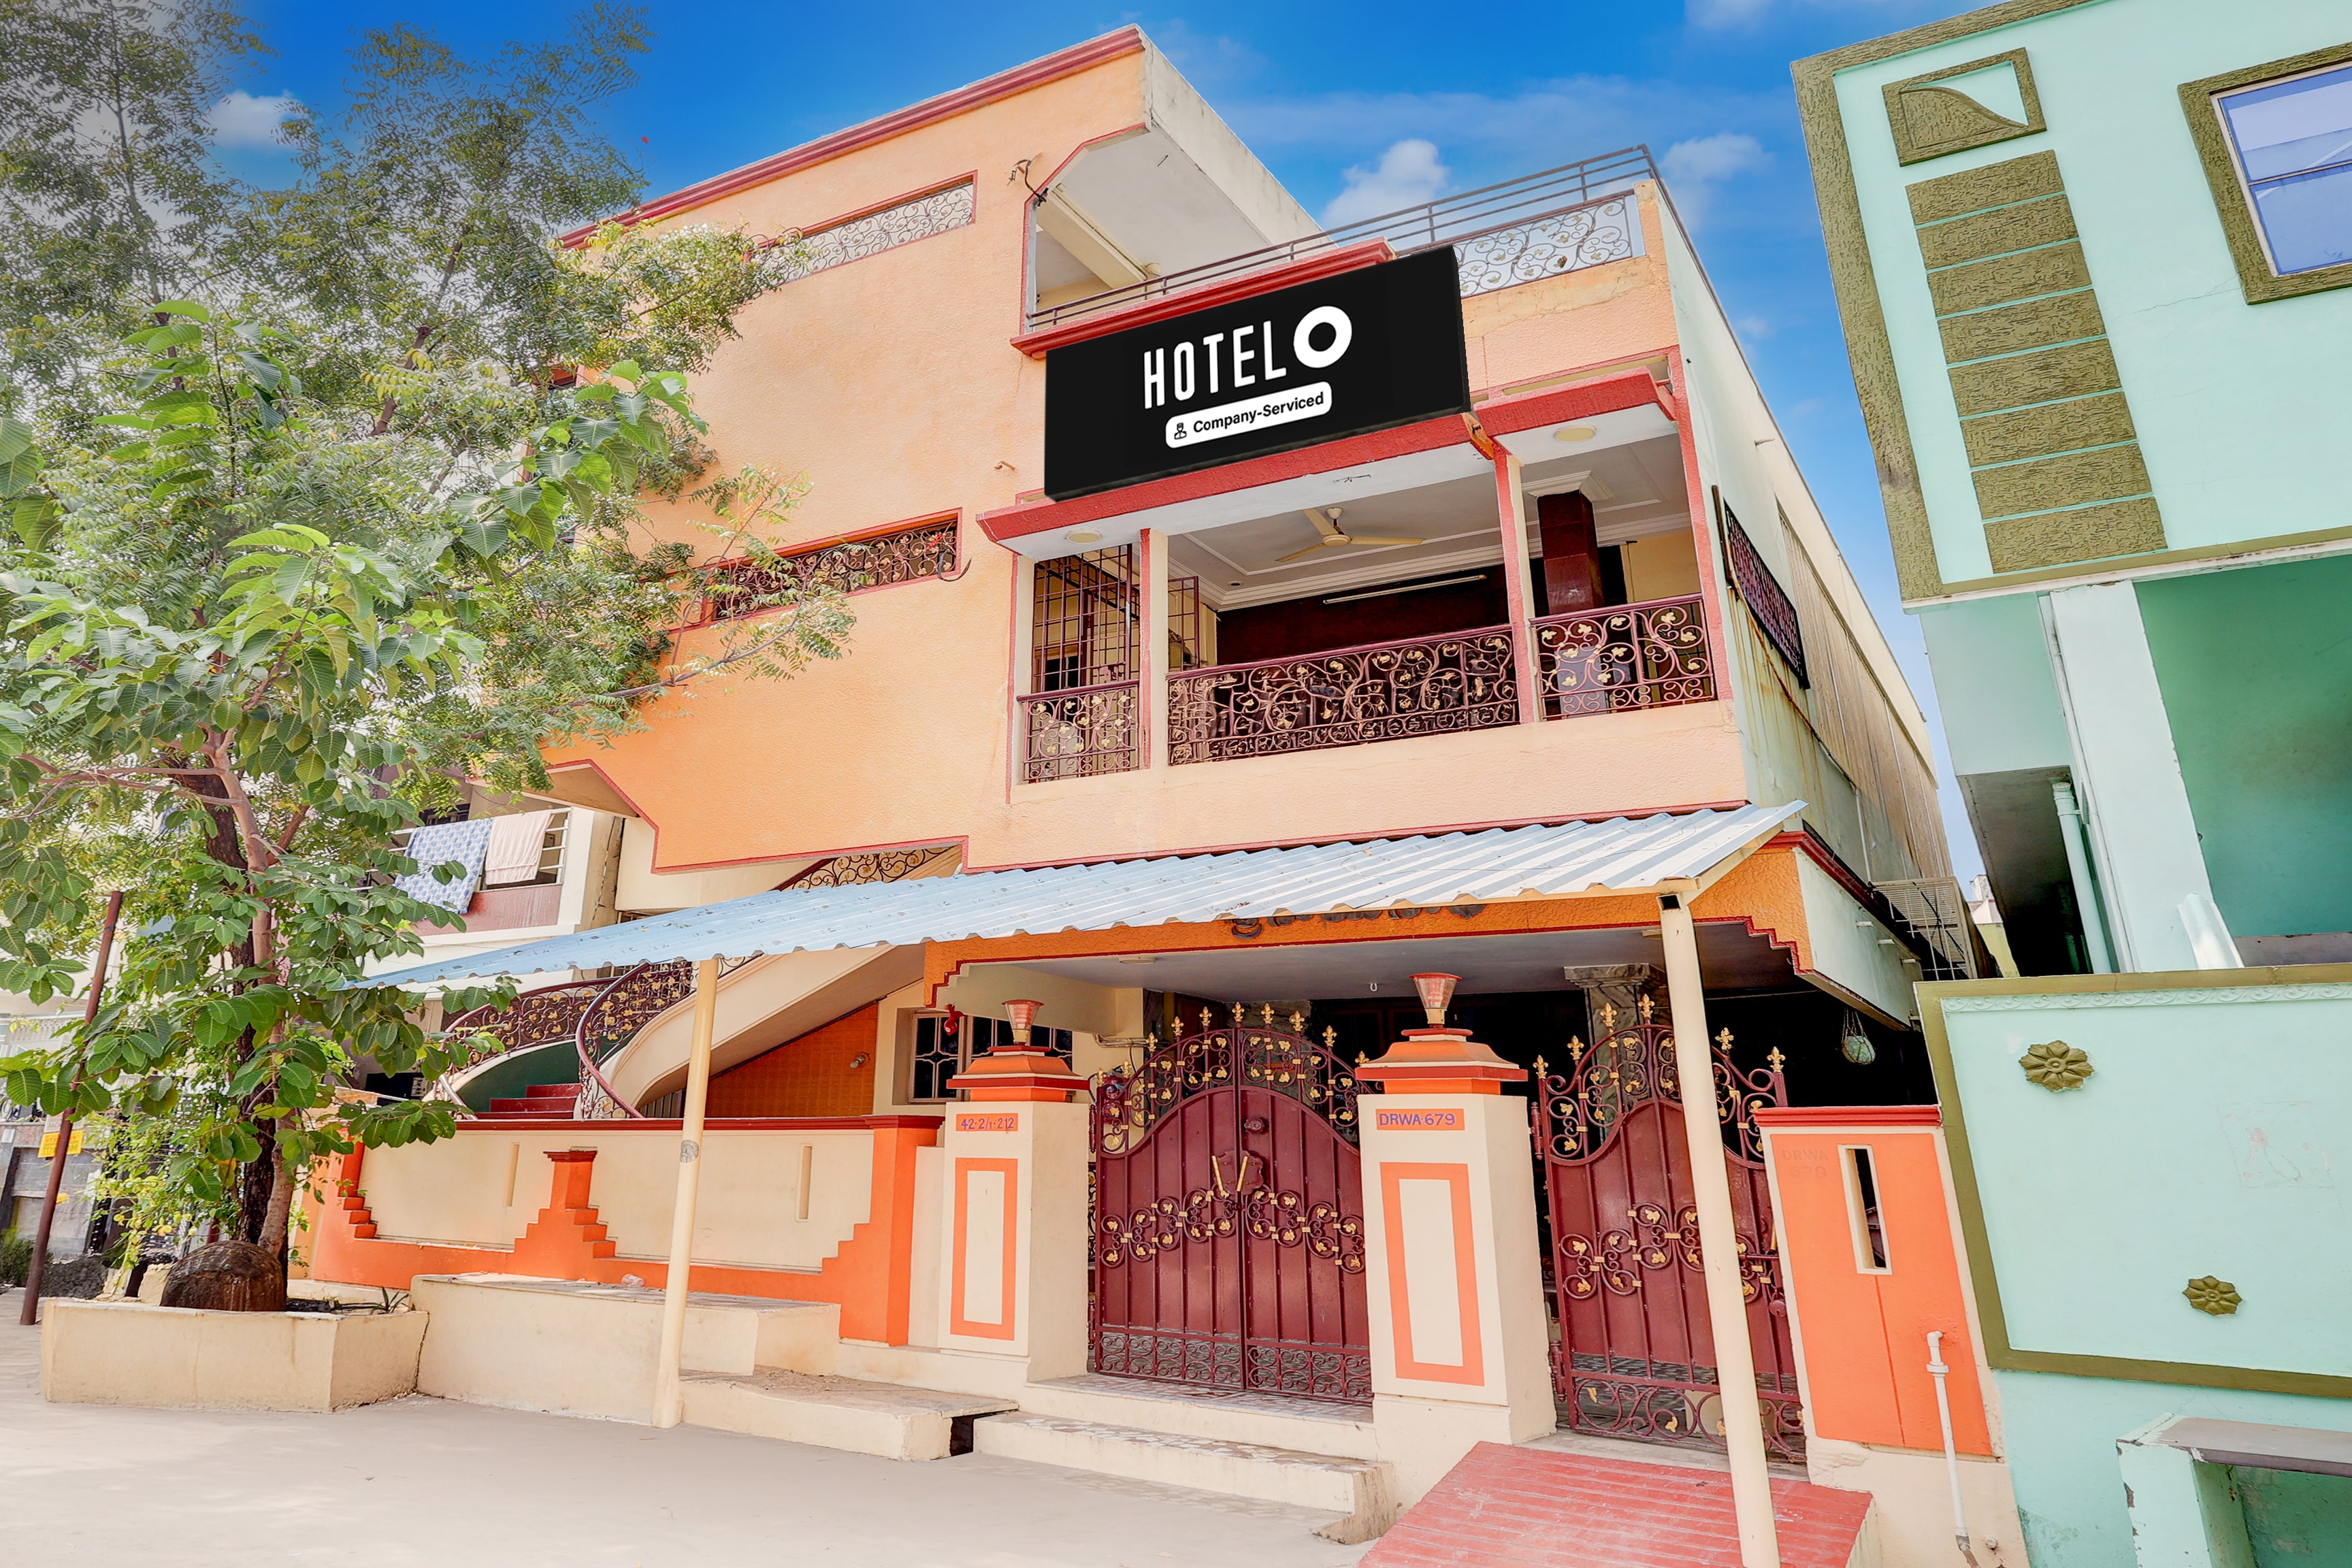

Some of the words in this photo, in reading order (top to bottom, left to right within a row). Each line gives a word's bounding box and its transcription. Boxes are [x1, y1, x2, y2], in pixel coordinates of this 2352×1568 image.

[1144, 321, 1287, 409] HOTEL
[1293, 306, 1352, 368] O
[1193, 391, 1324, 433] Company-Serviced
